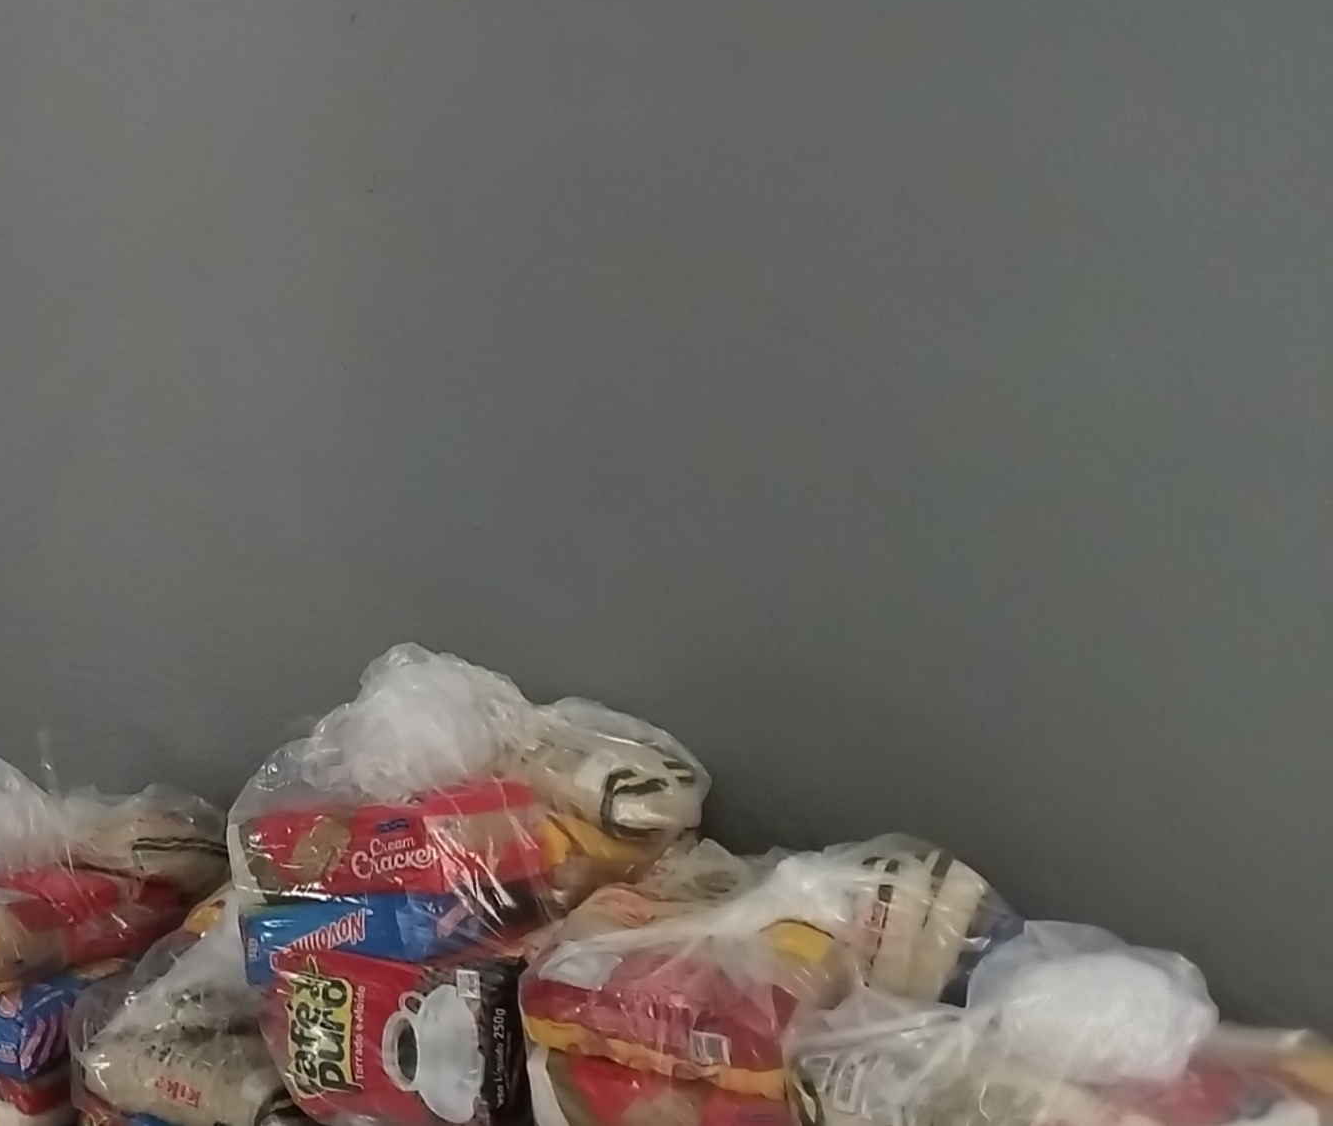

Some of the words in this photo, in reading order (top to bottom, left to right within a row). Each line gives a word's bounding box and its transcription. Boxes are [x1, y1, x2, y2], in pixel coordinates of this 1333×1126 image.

[351, 844, 439, 881] Cracker
[370, 837, 416, 856] Cream
[492, 1007, 508, 1040] 250g
[354, 1033, 366, 1081] Torrado
